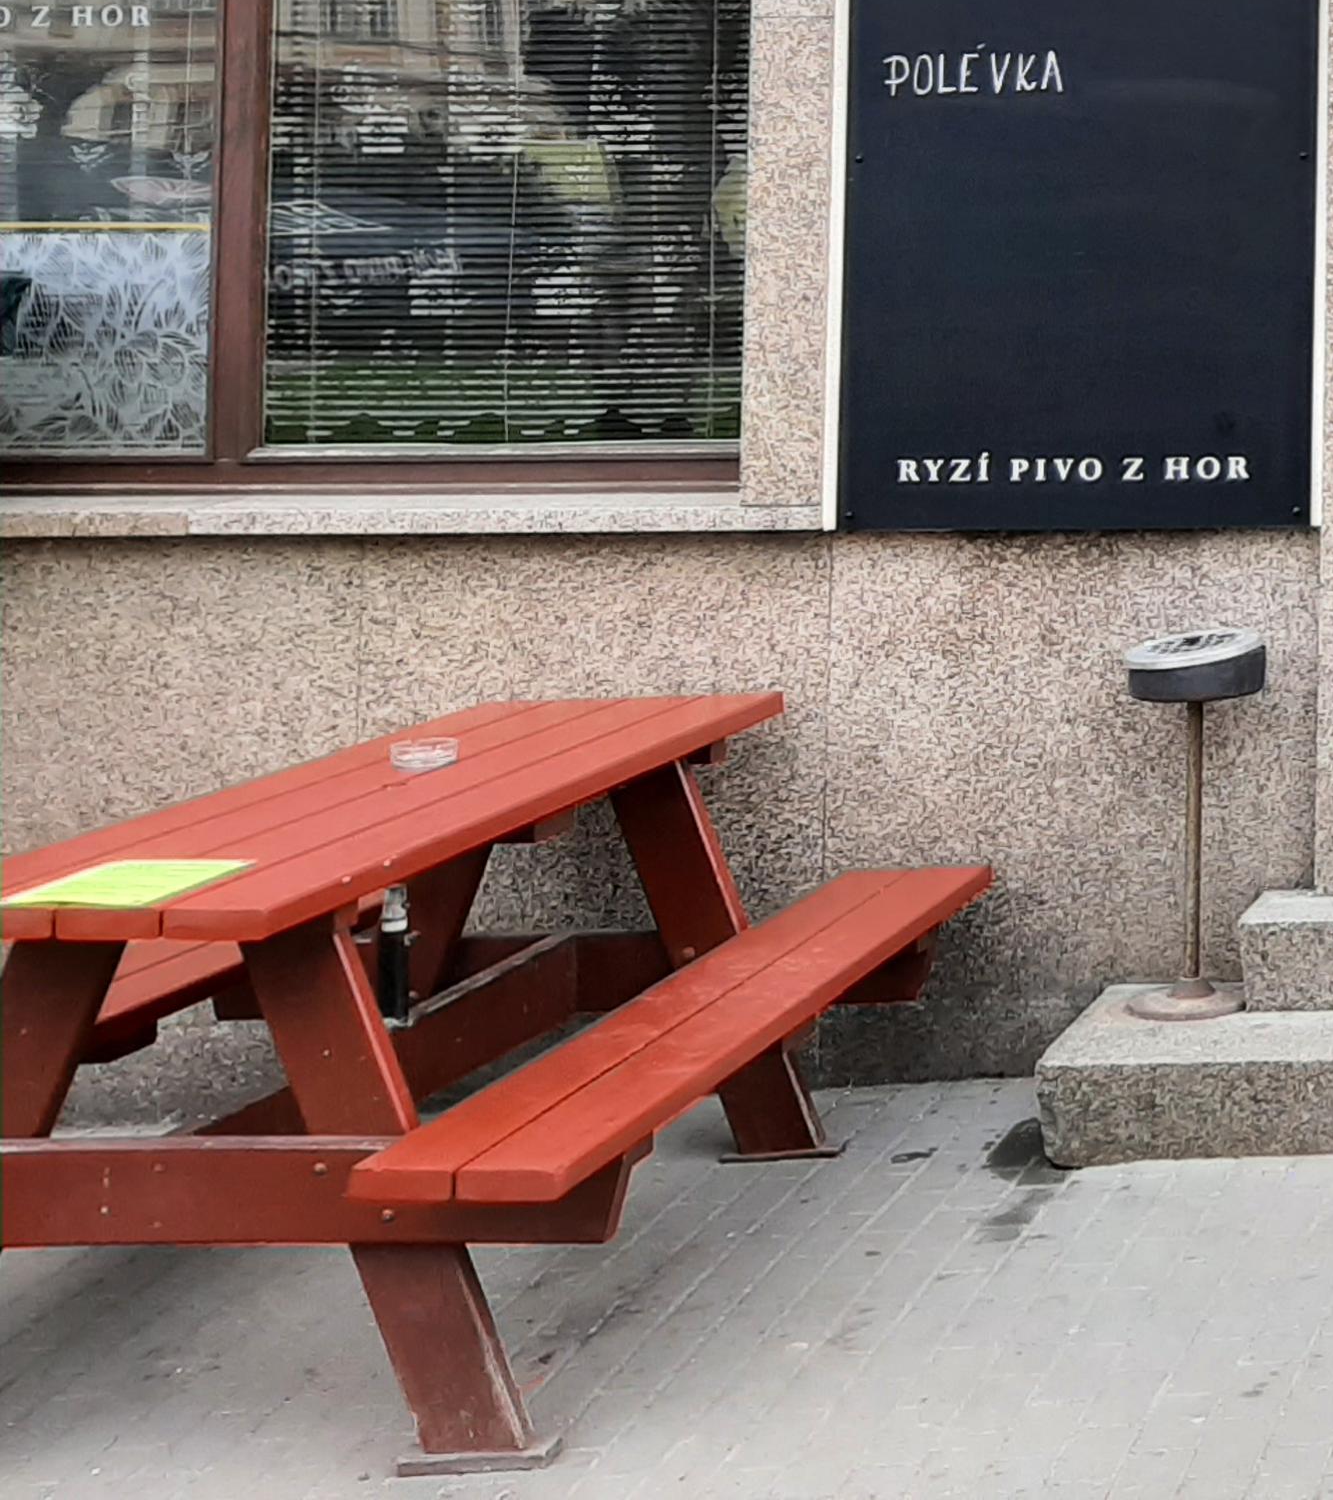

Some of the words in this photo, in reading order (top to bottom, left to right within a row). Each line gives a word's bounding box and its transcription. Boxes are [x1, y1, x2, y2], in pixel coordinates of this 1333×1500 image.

[31, 5, 51, 28] Z
[71, 4, 151, 28] HOR
[882, 43, 1064, 97] POLÉVKA
[897, 451, 989, 482] RYZÍ
[1009, 457, 1103, 482] PIVO
[1122, 457, 1144, 481] Z
[1164, 456, 1250, 481] HOR
